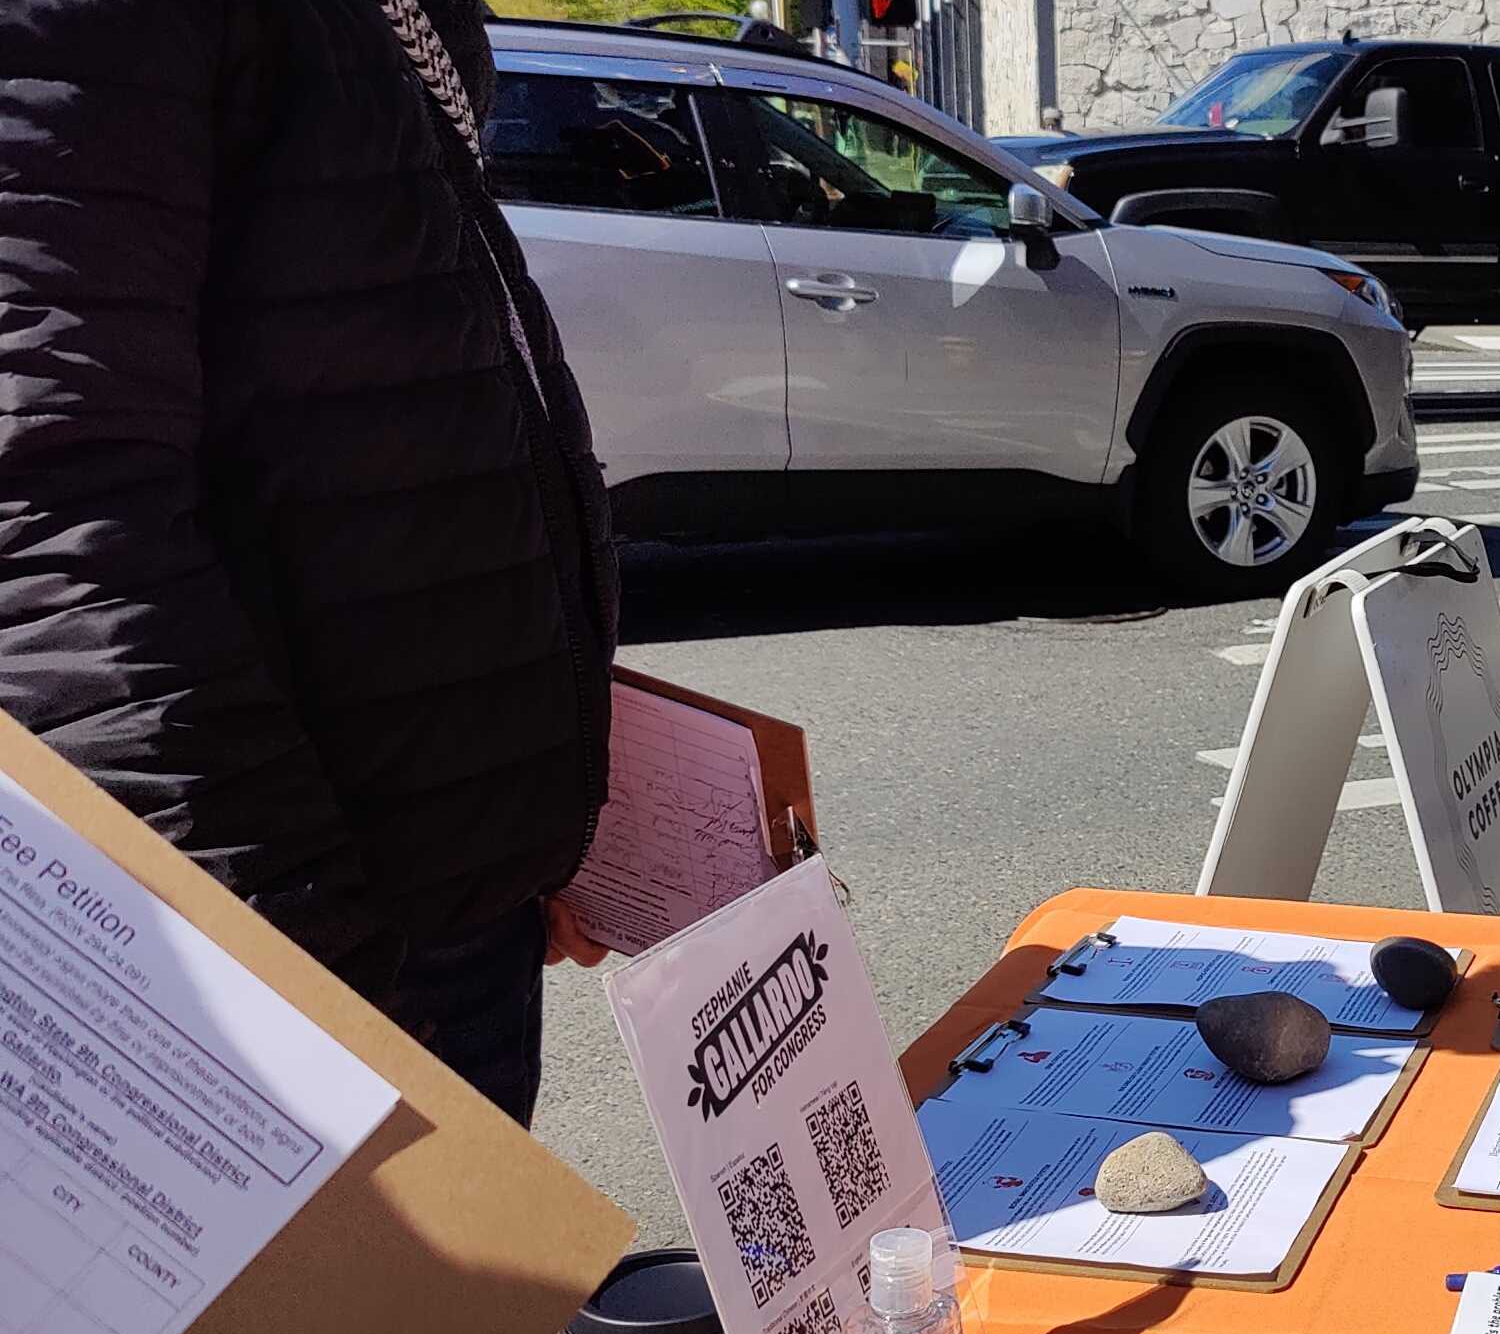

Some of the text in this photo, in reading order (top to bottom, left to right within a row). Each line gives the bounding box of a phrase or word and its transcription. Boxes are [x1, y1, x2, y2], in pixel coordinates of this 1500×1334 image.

[35, 855, 142, 948] Petition
[691, 961, 753, 1039] STEPHANIE
[702, 946, 817, 1101] GALLARDO
[35, 1011, 78, 1050] State
[74, 1042, 104, 1071] 9th
[97, 1061, 203, 1150] Congressional
[196, 1139, 254, 1190] District
[751, 1004, 828, 1105] FOR CONGRESS
[47, 1111, 155, 1202] Congressional
[148, 1190, 206, 1241] District
[124, 1242, 182, 1291] COUNTY
